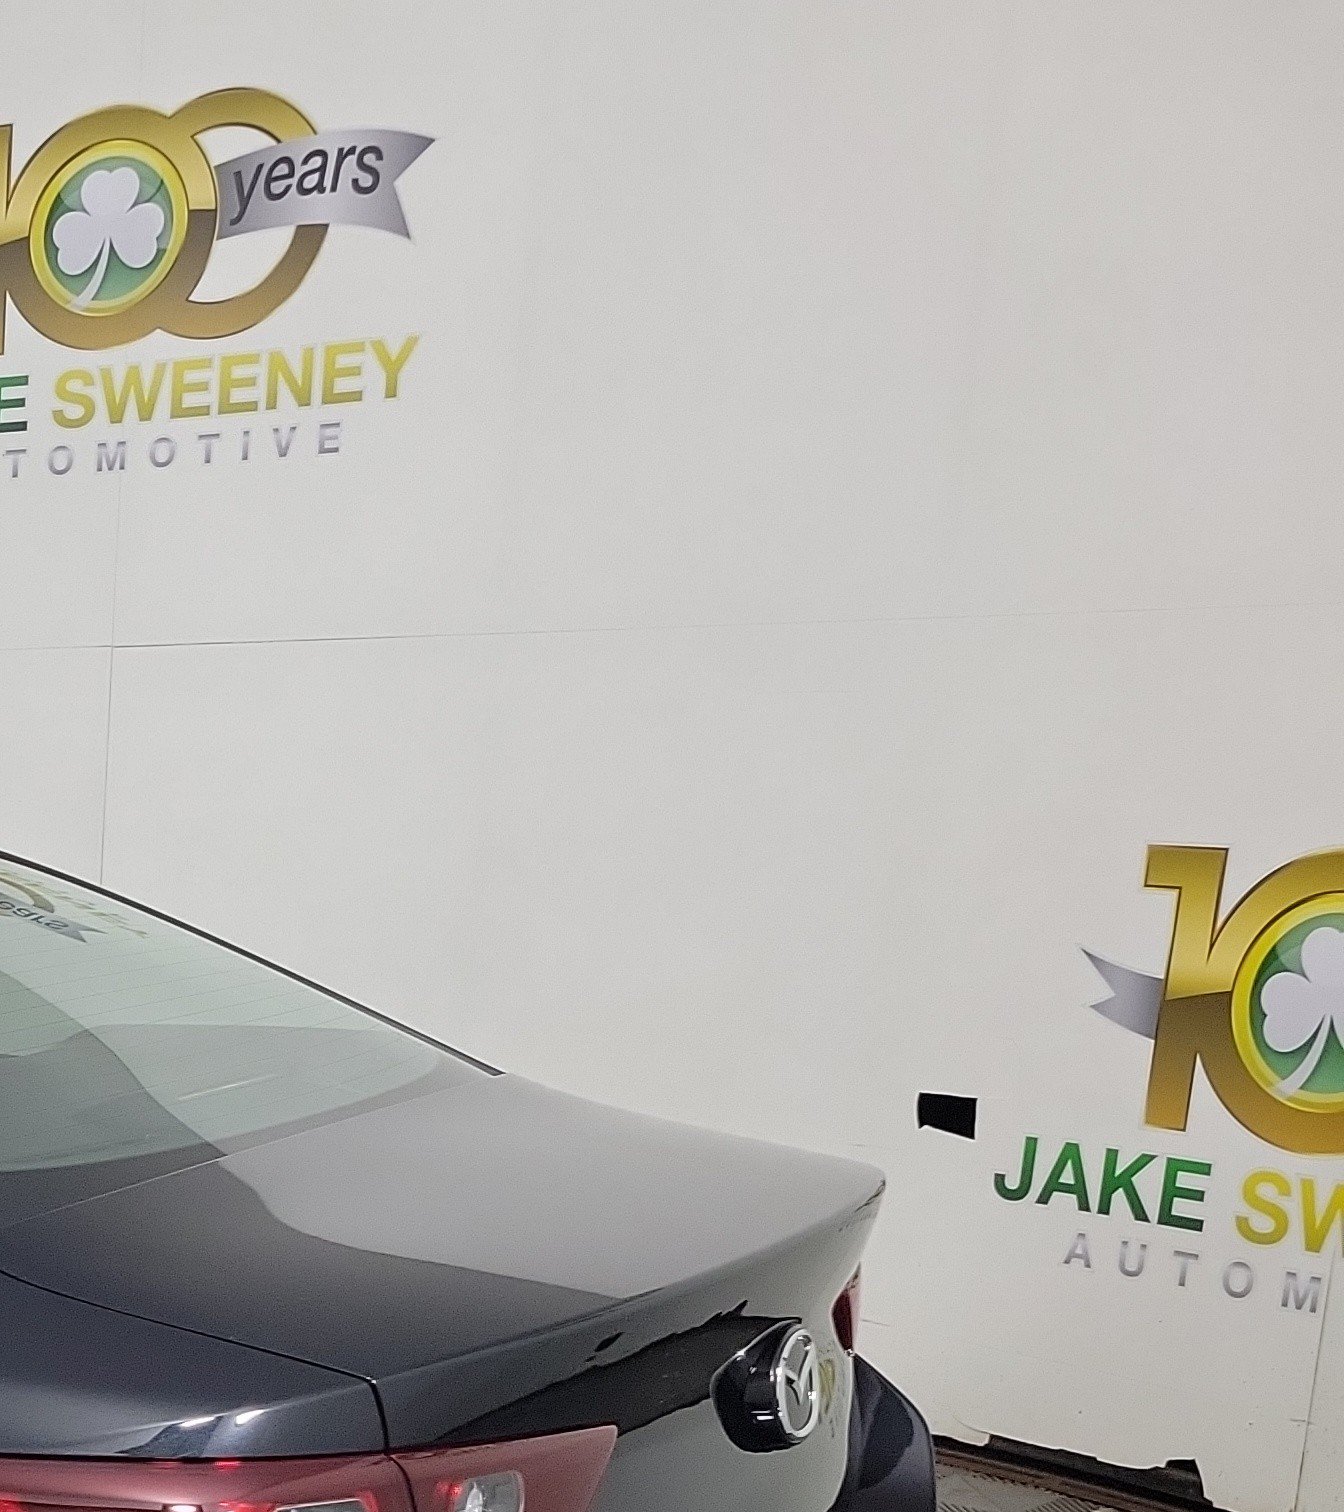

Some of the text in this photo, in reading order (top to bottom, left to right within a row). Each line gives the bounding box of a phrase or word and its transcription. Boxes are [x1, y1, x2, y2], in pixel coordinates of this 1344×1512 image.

[229, 140, 382, 226] years
[51, 334, 420, 430] SWEENEY
[993, 1135, 1212, 1232] JAKE
[1062, 1231, 1322, 1314] AUTOM
